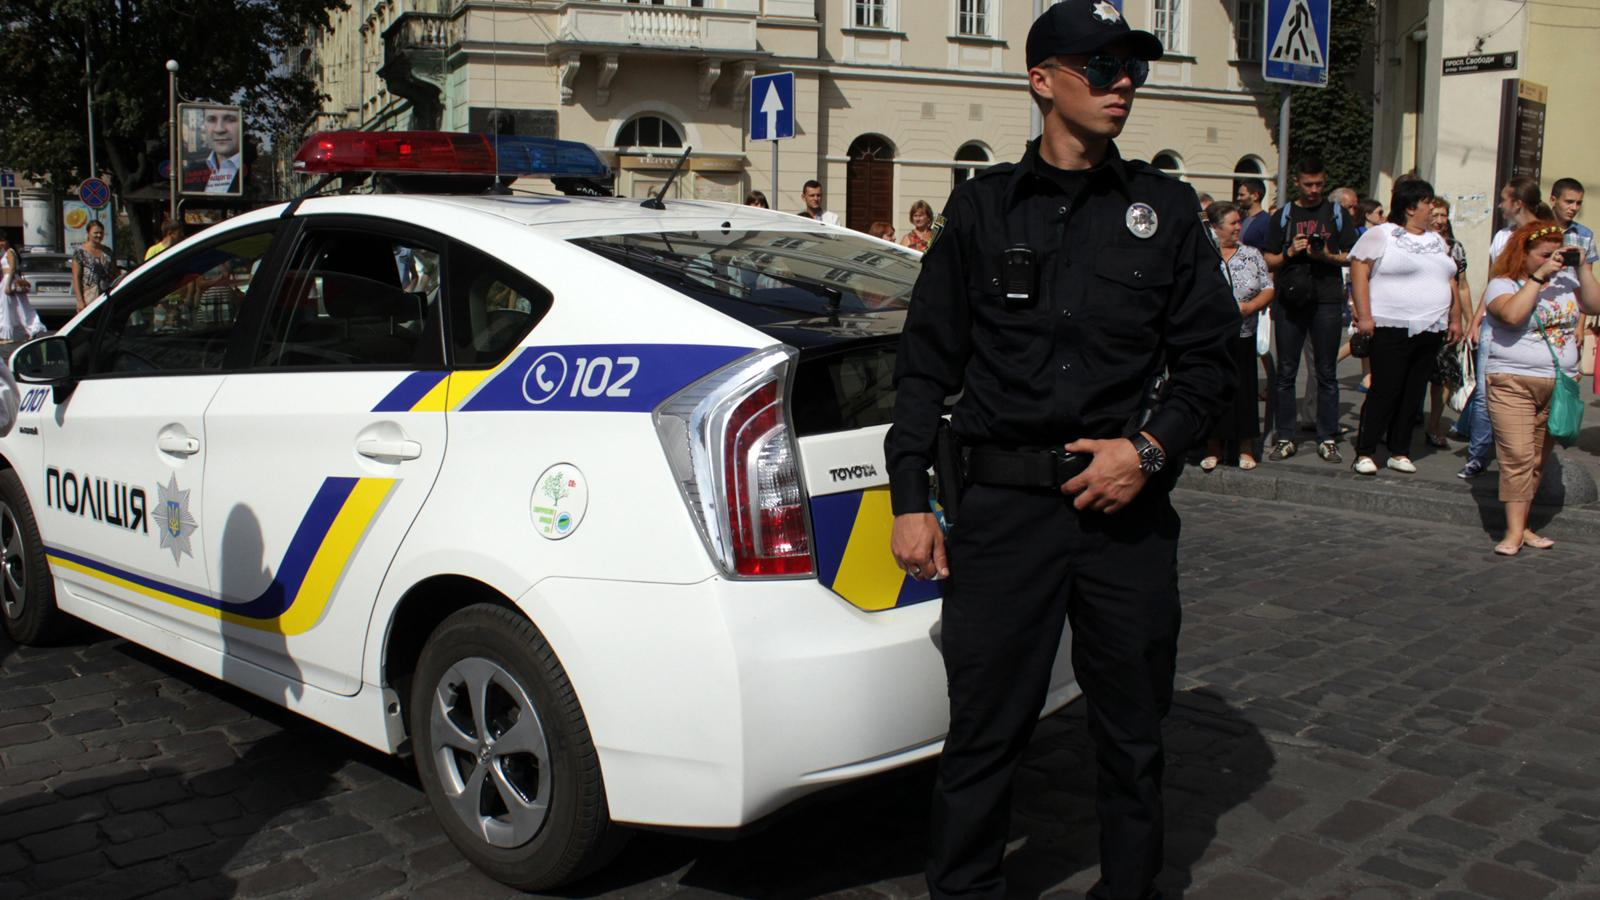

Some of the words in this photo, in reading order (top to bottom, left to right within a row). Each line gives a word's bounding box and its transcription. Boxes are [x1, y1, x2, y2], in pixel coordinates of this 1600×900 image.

[570, 356, 640, 398] 102
[829, 464, 877, 482] TOYOTA
[46, 466, 149, 534] ПОЛІЦІЯ
